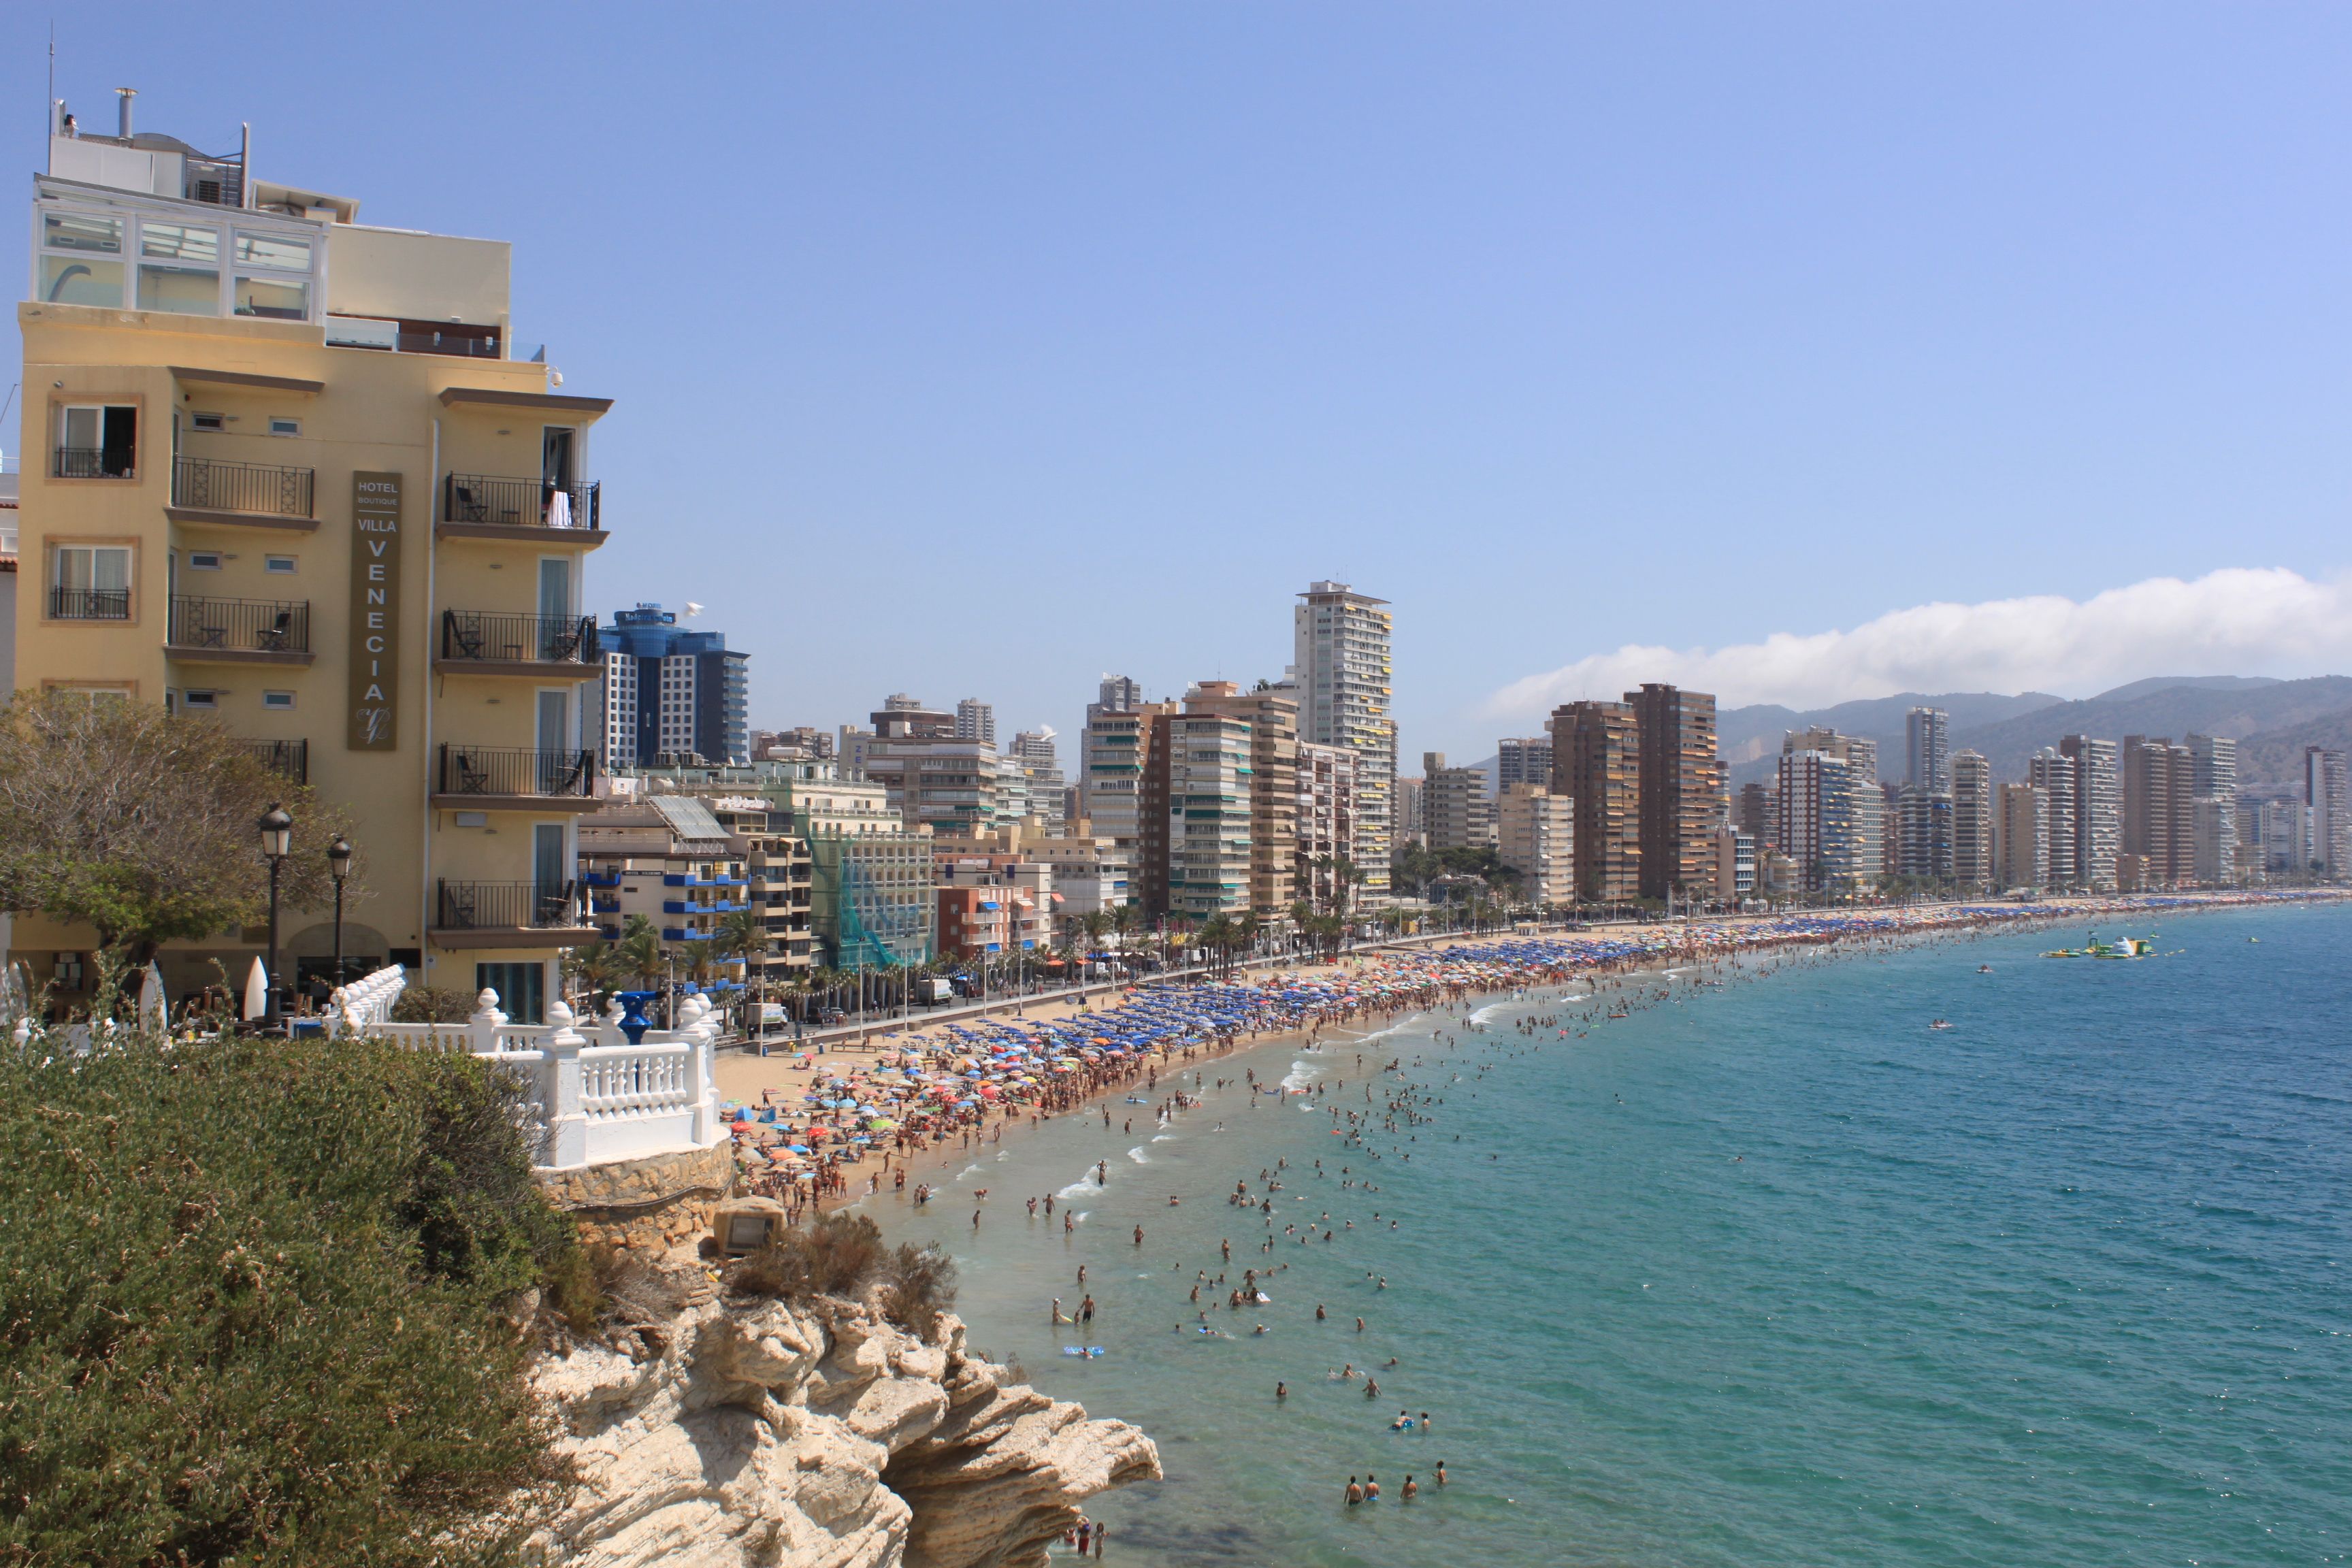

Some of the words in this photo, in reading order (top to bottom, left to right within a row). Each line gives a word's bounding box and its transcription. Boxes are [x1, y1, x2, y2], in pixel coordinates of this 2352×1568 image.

[359, 482, 398, 493] HOTEL
[358, 497, 397, 506] BOUTIQUE
[358, 519, 397, 532] VILLA
[364, 540, 387, 700] VENECIA
